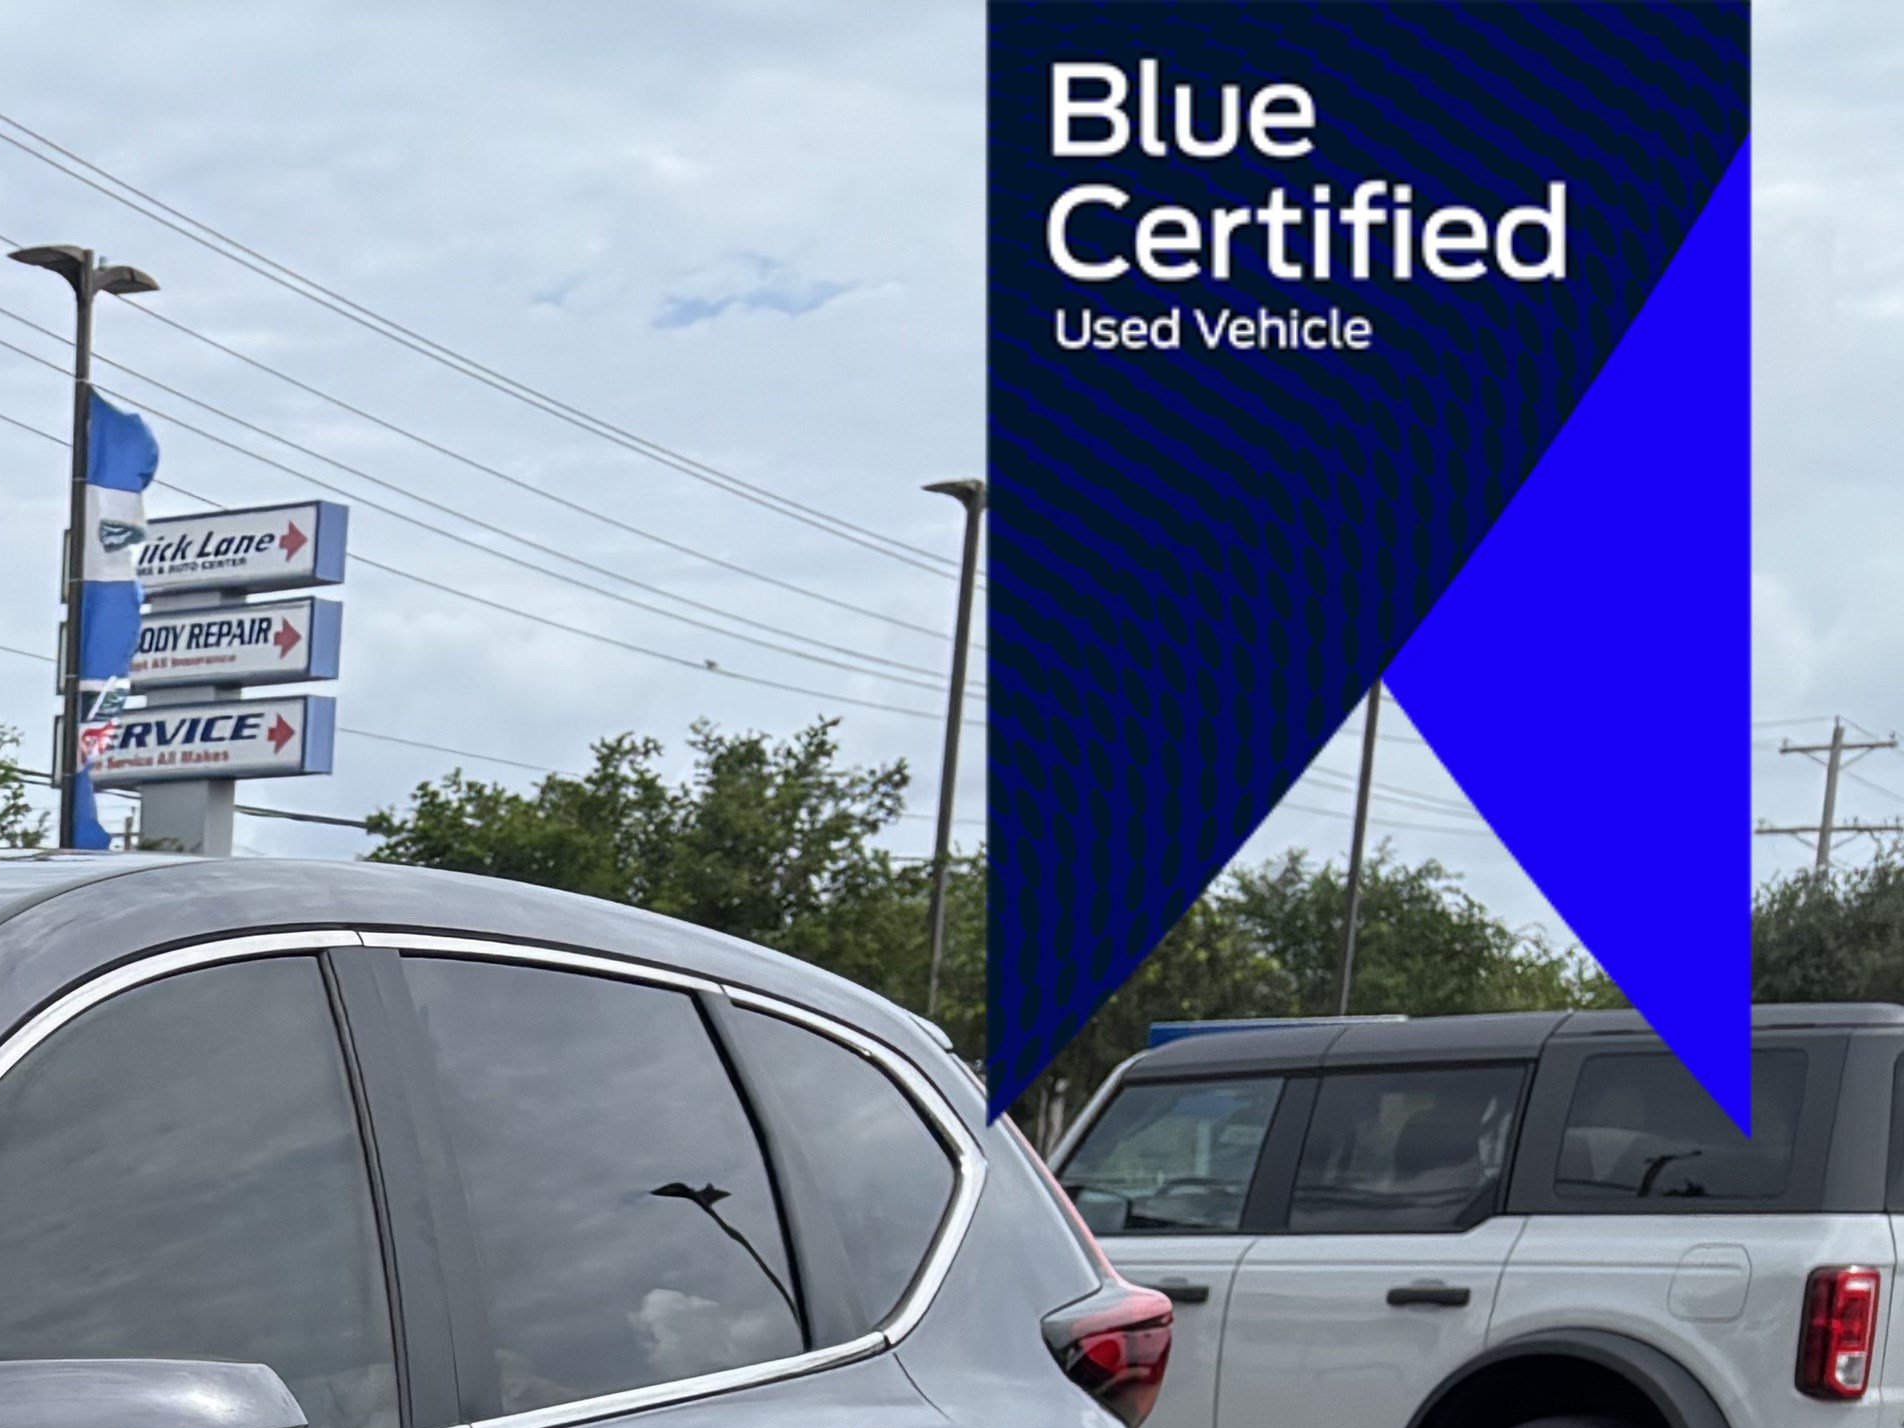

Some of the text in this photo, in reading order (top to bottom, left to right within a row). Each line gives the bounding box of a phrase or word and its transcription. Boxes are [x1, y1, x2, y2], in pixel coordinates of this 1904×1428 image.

[197, 530, 275, 559] Lane
[138, 616, 273, 654] ODY REPAIR
